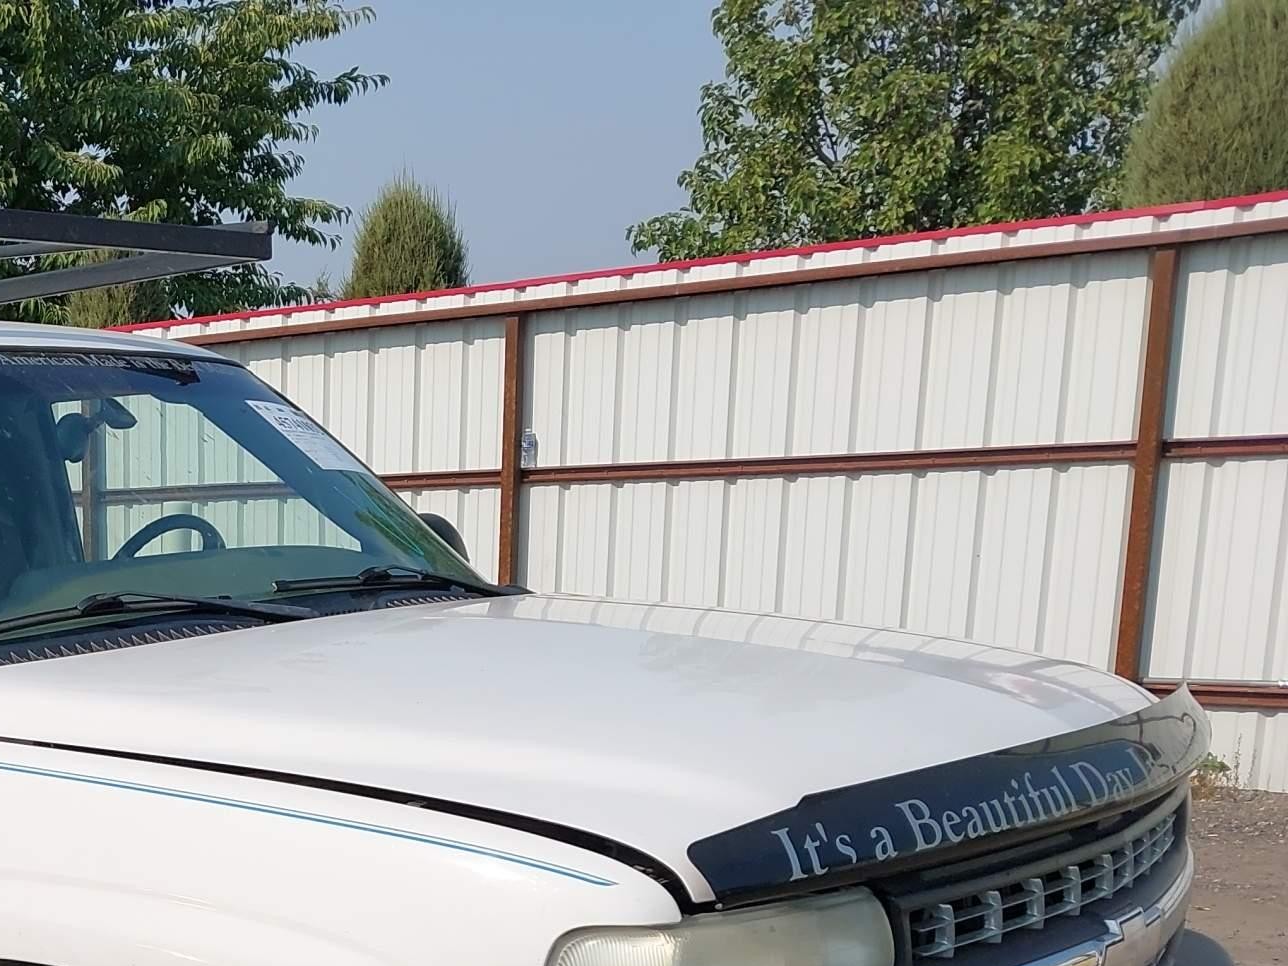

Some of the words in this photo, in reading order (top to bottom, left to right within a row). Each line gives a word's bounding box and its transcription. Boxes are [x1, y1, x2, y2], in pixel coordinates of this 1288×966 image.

[81, 354, 131, 368] Made
[146, 358, 172, 370] the
[772, 822, 858, 881] It's
[870, 825, 898, 862] a
[895, 766, 1077, 852] Beautiful
[1069, 761, 1134, 806] Day
